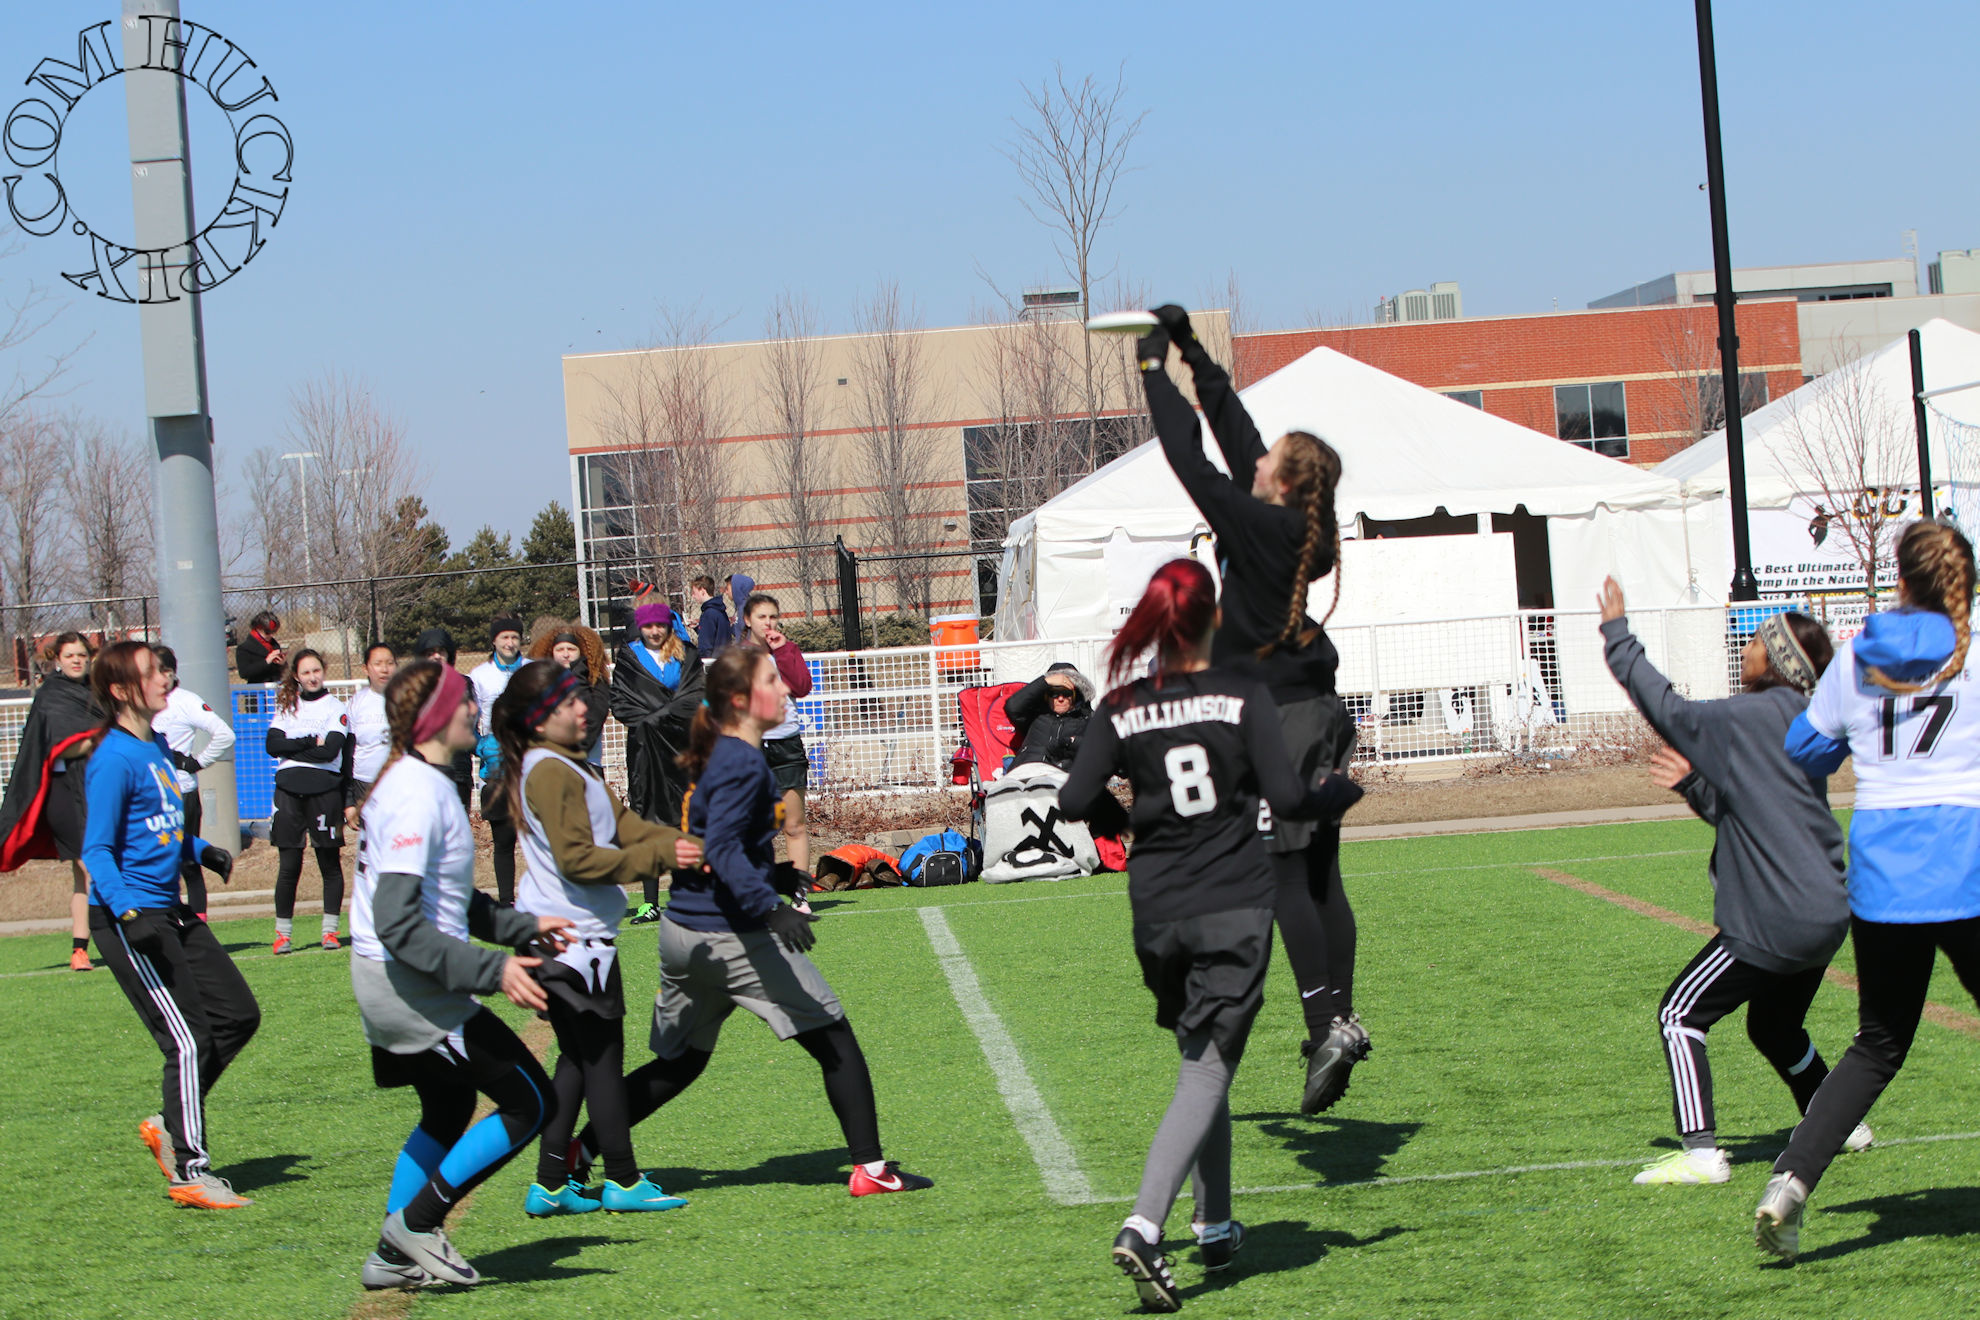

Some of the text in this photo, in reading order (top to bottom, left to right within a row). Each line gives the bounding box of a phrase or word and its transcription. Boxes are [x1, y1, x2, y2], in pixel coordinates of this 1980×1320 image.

[1755, 578, 1782, 588] amp
[1786, 577, 1799, 586] in
[1802, 575, 1824, 585] the
[1765, 564, 1793, 574] Best
[1797, 561, 1856, 573] Ultimate
[1111, 694, 1245, 739] WILLIAMSON
[1878, 691, 1959, 761] 17
[1164, 743, 1218, 818] 8
